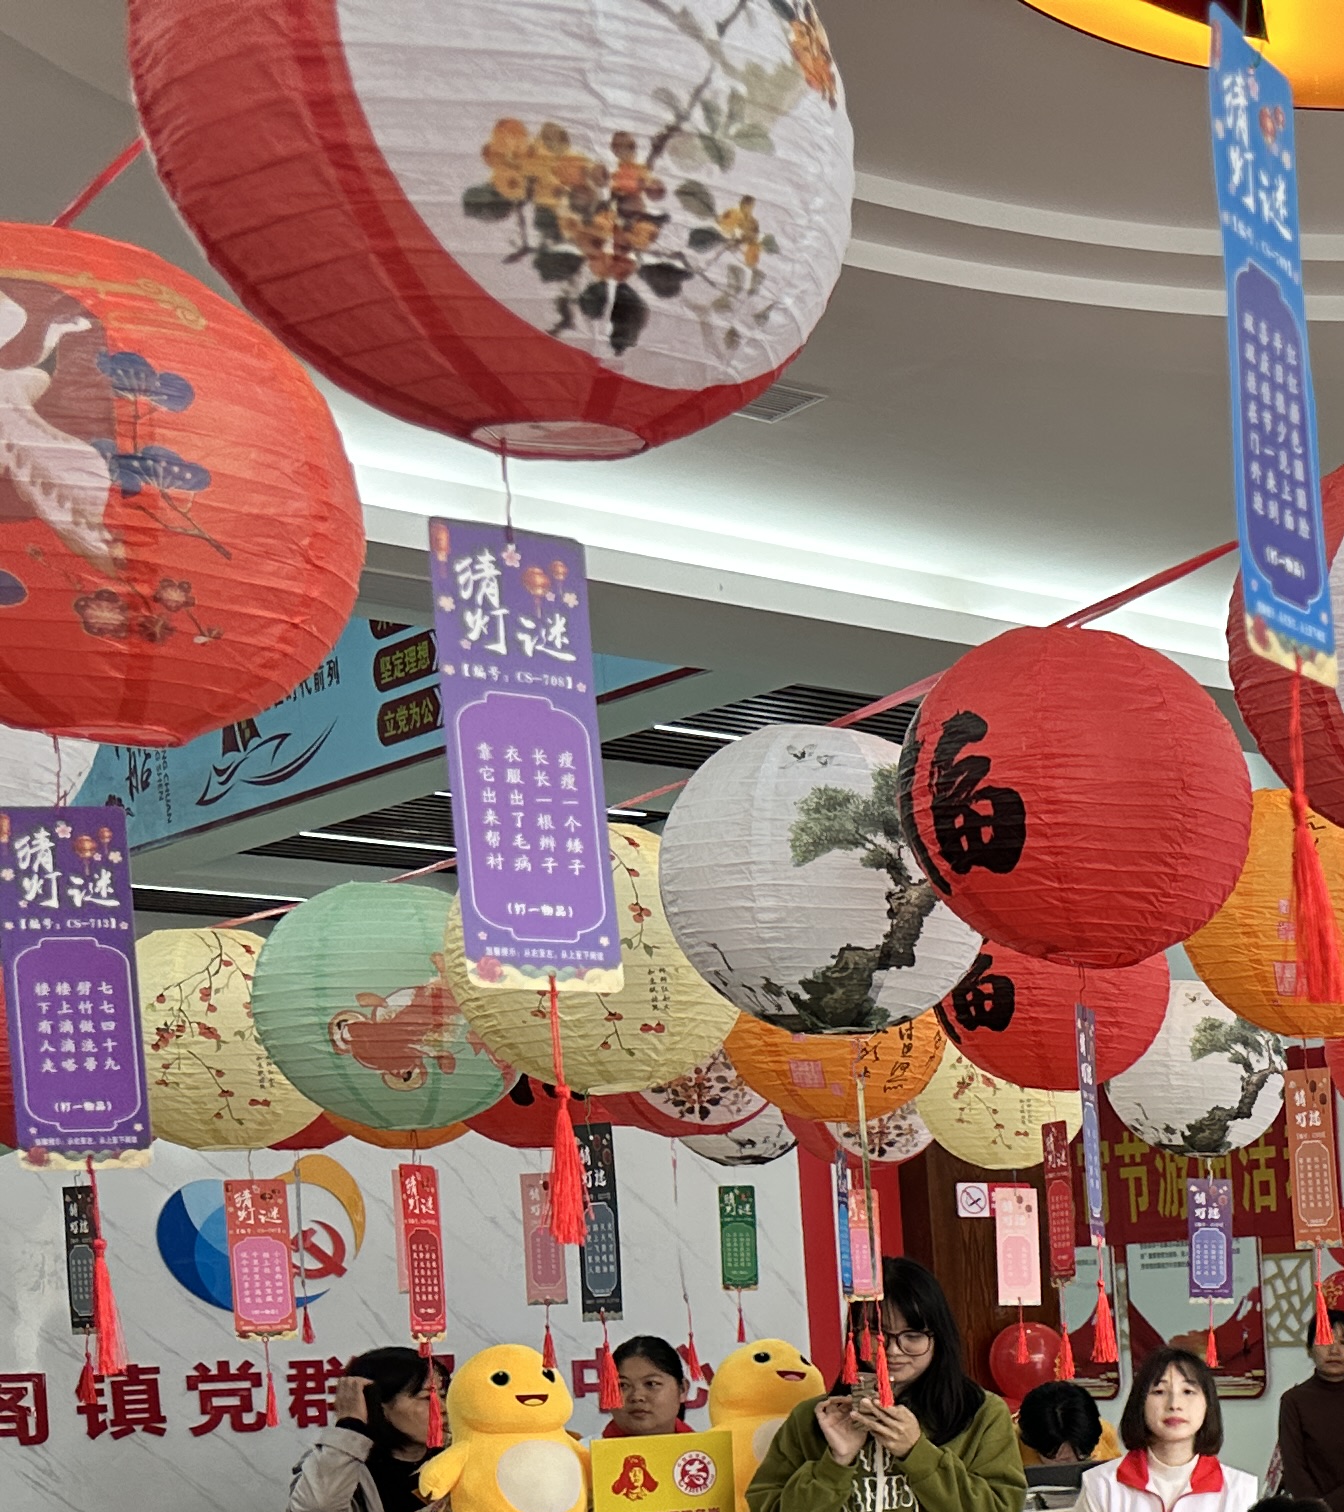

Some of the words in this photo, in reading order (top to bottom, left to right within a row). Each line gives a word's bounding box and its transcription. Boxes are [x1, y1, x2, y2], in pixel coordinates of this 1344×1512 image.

[379, 640, 431, 685] 坚定理想
[383, 697, 434, 738] 立党为公
[504, 745, 532, 872] 衣服出了毛病
[97, 981, 121, 1071] 七七四十九
